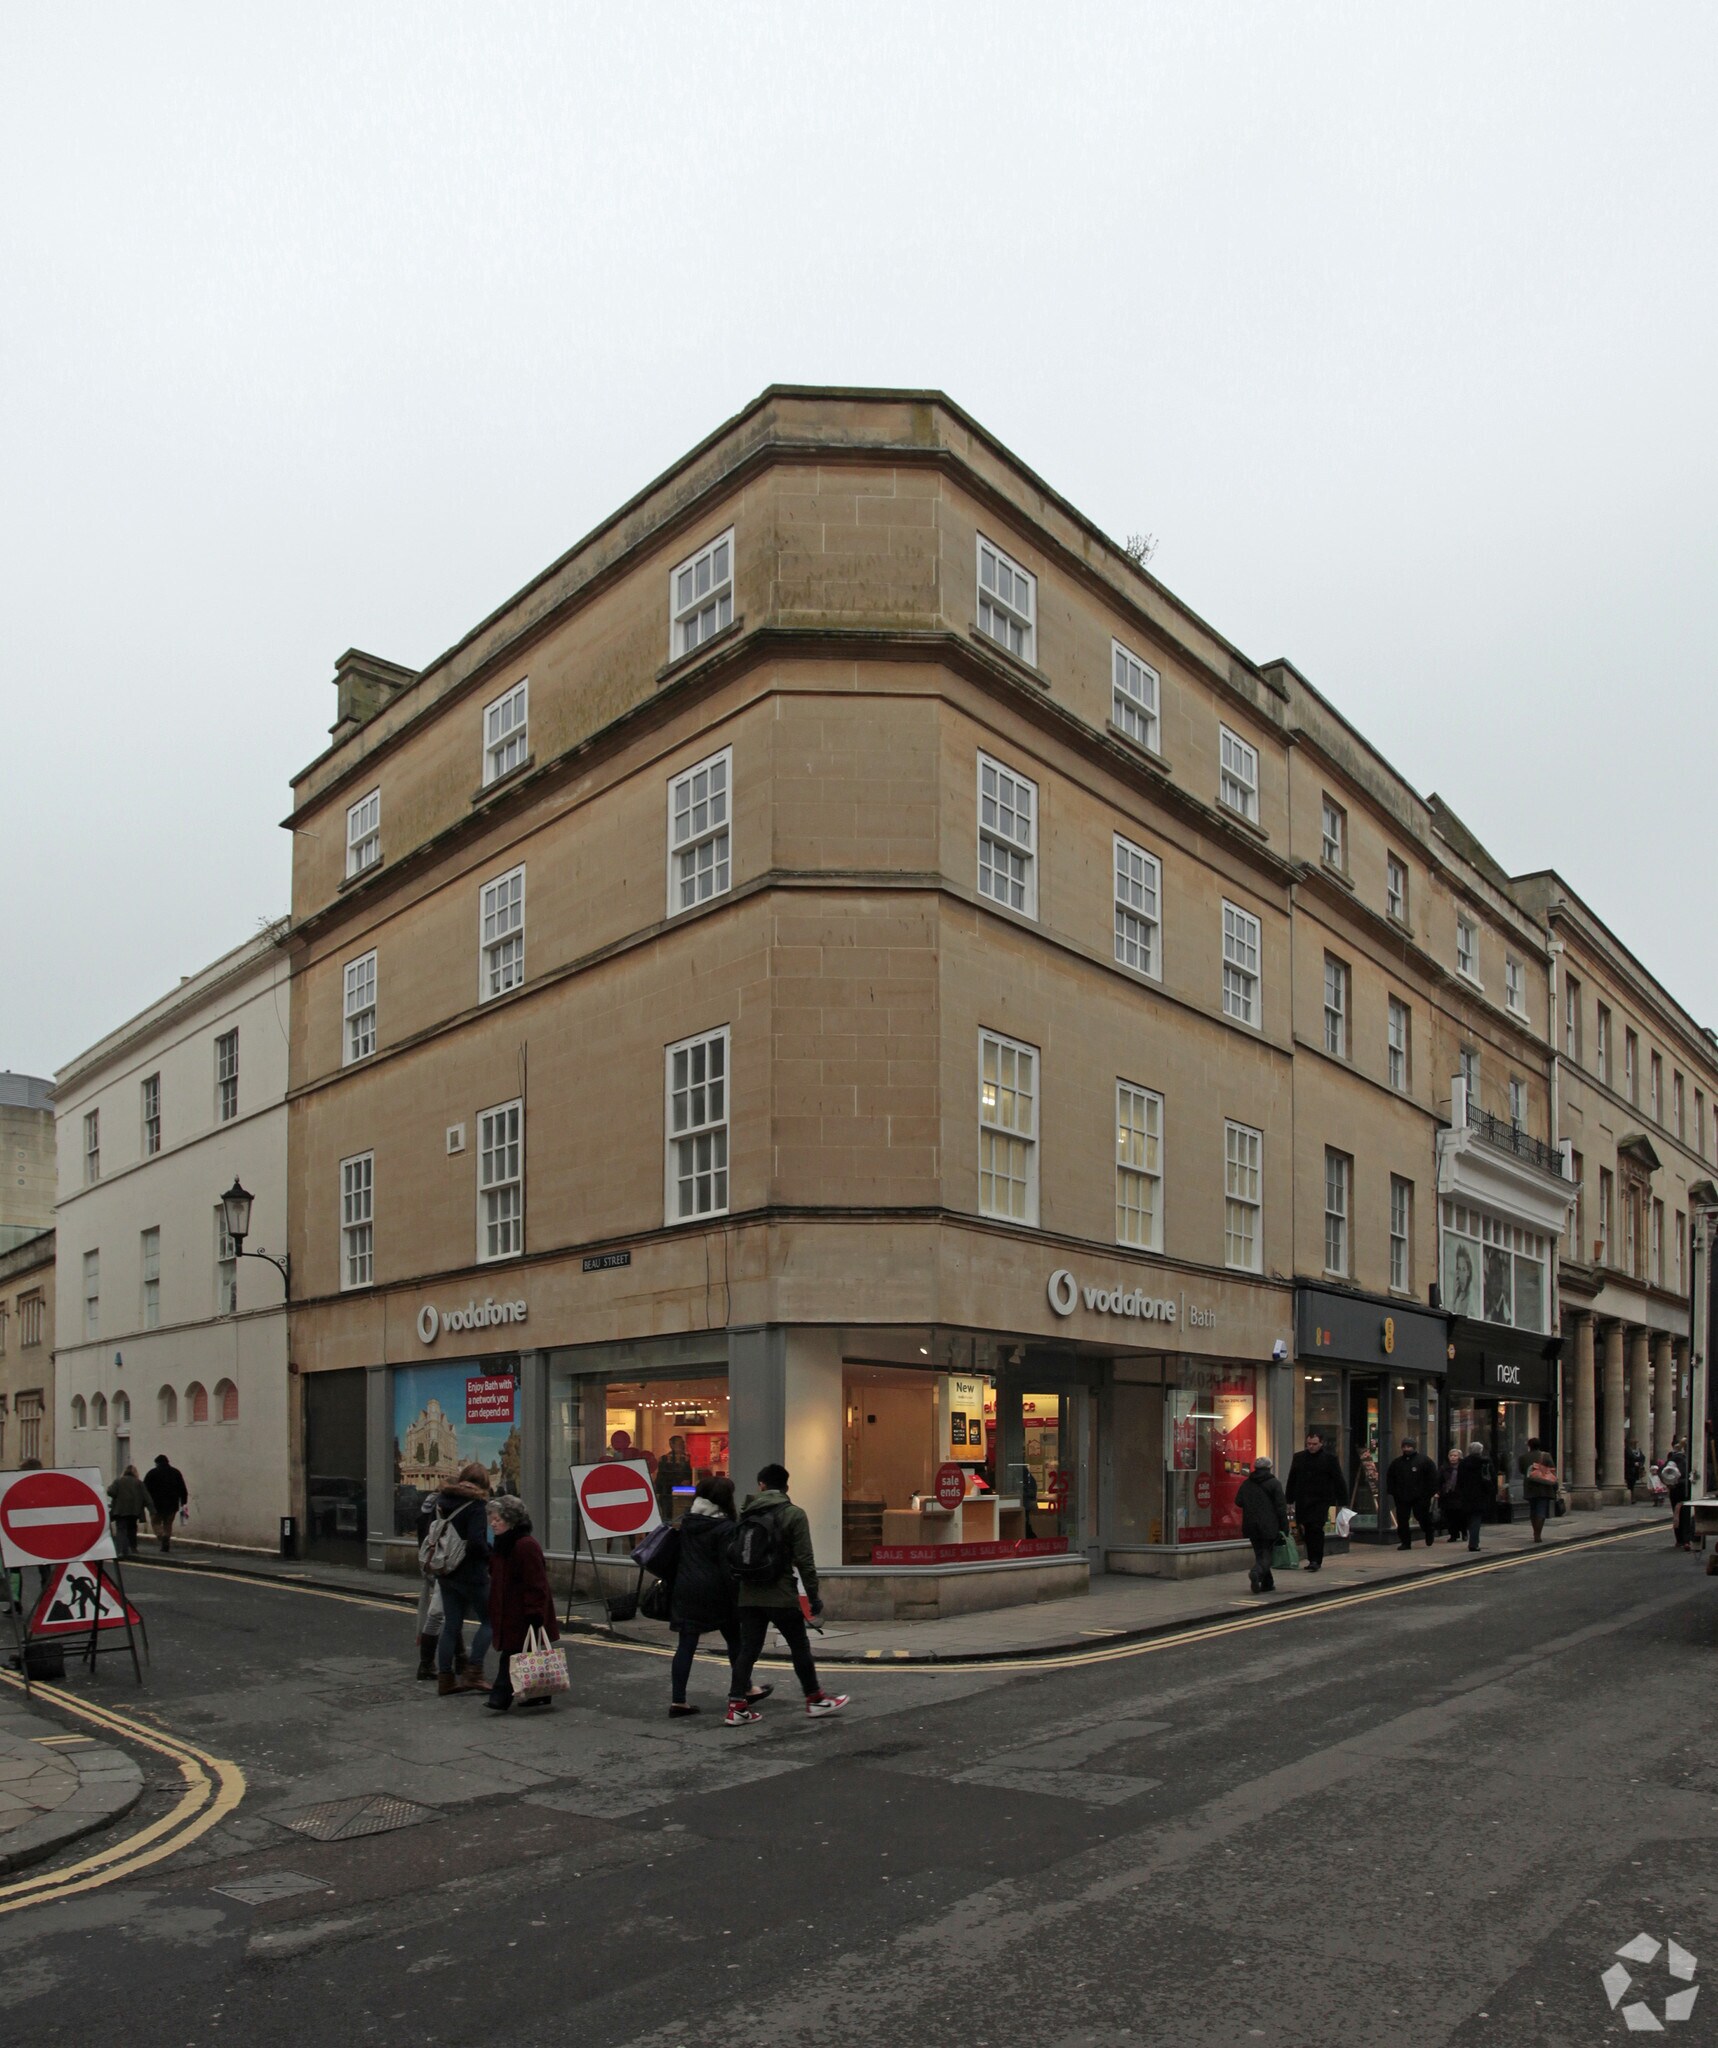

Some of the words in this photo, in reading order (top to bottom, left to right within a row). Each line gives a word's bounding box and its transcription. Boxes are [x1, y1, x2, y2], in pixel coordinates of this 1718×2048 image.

[584, 1259, 600, 1270] BEAU
[603, 1254, 629, 1267] STREET
[1083, 1284, 1177, 1322] vodafone
[1190, 1305, 1216, 1328] Bath
[442, 1298, 527, 1331] vodafone
[1497, 1364, 1521, 1385] next
[467, 1381, 484, 1393] Enjoy
[484, 1380, 498, 1391] Bath
[498, 1379, 512, 1390] with
[956, 1382, 975, 1393] New
[472, 1394, 496, 1404] network
[496, 1395, 509, 1405] you
[468, 1410, 478, 1418] can
[479, 1407, 501, 1419] depend
[501, 1408, 510, 1416] on
[1215, 1438, 1252, 1452] SALE
[942, 1475, 960, 1486] sale
[1198, 1481, 1210, 1490] sale
[940, 1486, 961, 1497] ends
[1197, 1490, 1211, 1499] ends
[1048, 1495, 1068, 1513] off
[875, 1550, 903, 1560] SALE
[910, 1549, 935, 1560] SALE
[940, 1548, 956, 1558] SALE
[960, 1547, 976, 1557] SALE
[980, 1546, 996, 1556] SALE
